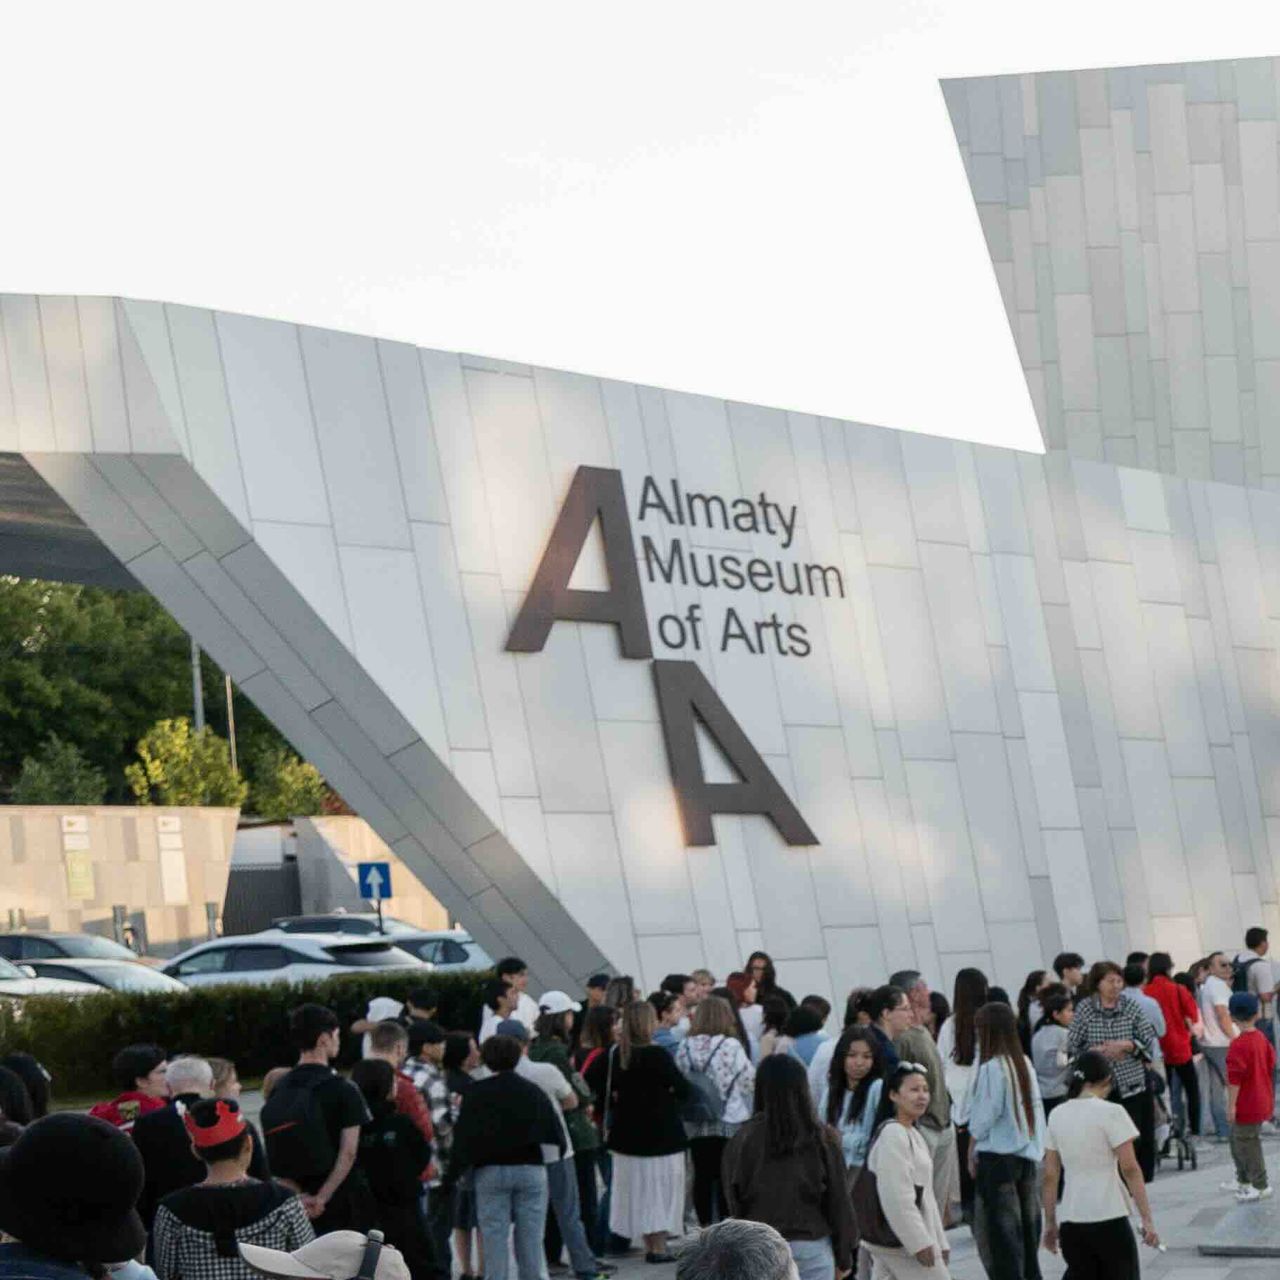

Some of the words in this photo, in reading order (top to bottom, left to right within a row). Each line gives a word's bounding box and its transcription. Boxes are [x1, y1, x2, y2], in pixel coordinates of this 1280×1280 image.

[638, 475, 797, 549] Almaty
[505, 465, 654, 660] A
[641, 535, 845, 599] Museum
[658, 604, 702, 650] of
[720, 606, 812, 657] Arts
[651, 658, 821, 847] A
